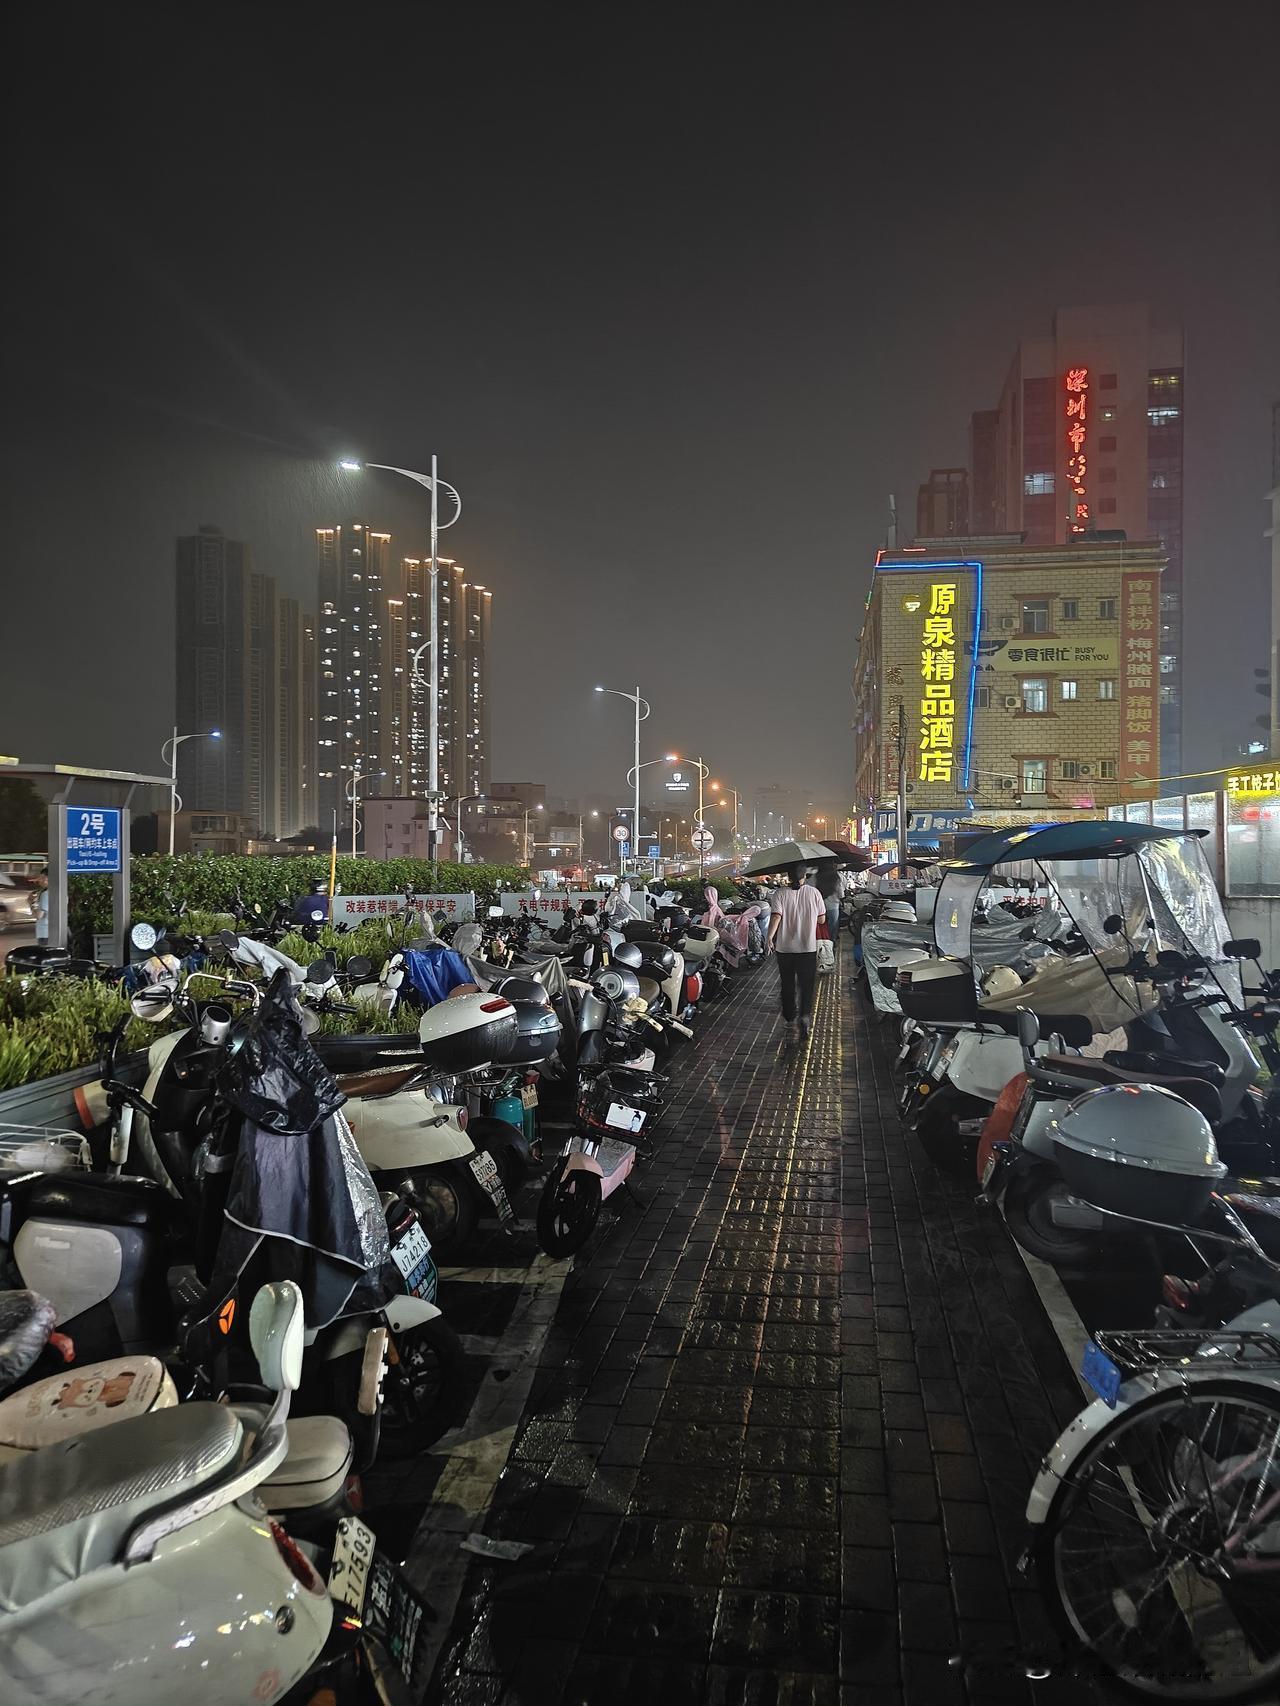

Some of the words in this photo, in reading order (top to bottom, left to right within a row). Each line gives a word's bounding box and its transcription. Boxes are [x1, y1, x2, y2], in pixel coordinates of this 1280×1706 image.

[1066, 368, 1089, 453] 深圳市
[1127, 580, 1153, 630] 南昌拌粉
[1007, 647, 1071, 662] 零食很忙
[1074, 646, 1096, 654] BUSY
[1126, 637, 1153, 689] 梅州腌面
[919, 583, 957, 783] 原泉精品酒店
[1126, 695, 1152, 734] 猪脚饭
[1126, 739, 1152, 765] 美甲
[80, 812, 105, 836] 2号
[400, 1235, 428, 1272] J74218
